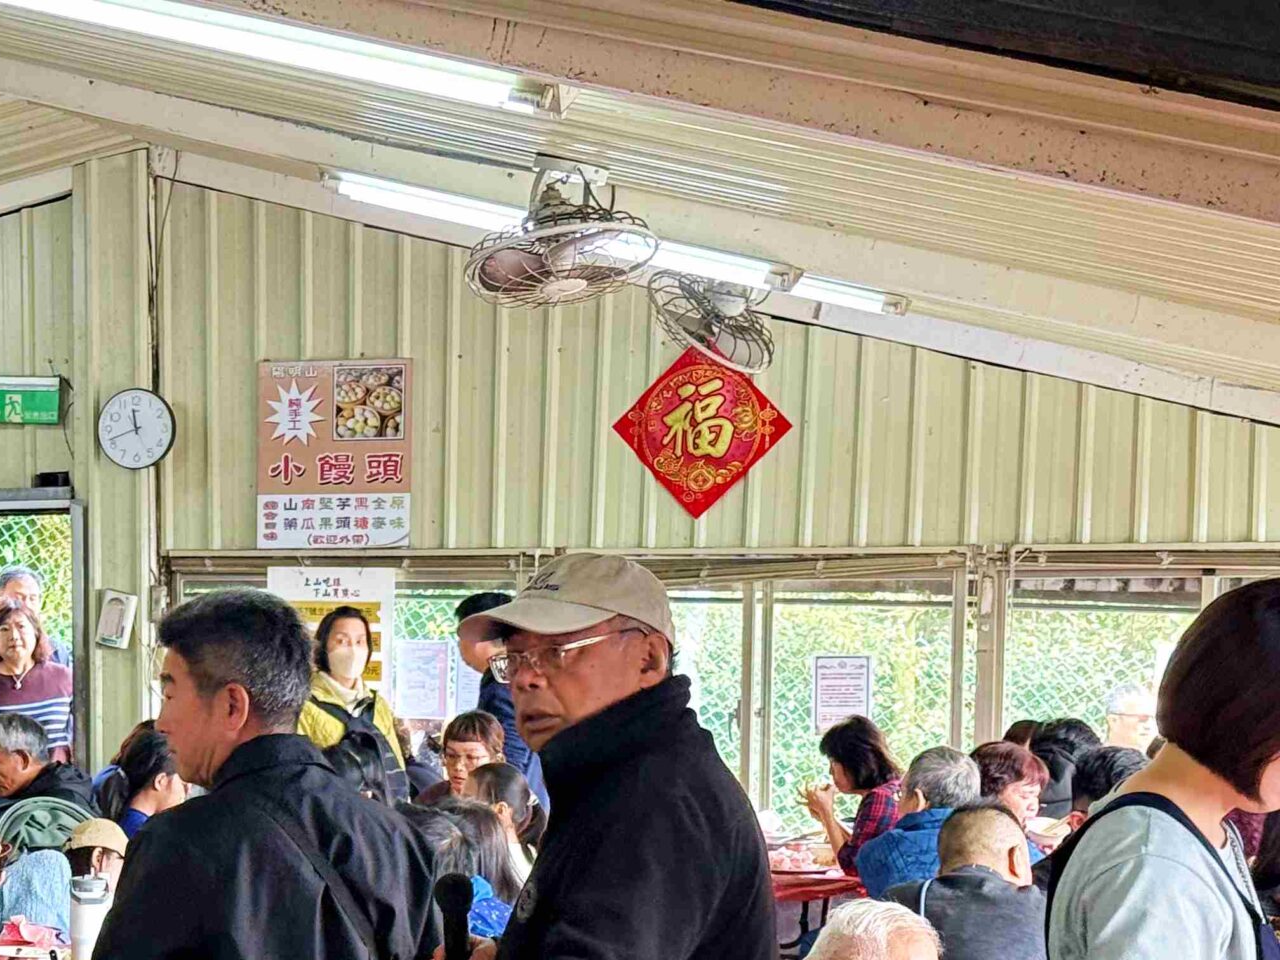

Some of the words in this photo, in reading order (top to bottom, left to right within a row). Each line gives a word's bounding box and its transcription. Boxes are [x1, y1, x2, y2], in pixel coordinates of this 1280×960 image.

[156, 408, 164, 419] 2
[662, 377, 735, 458] 福
[105, 425, 112, 435] 9
[161, 423, 168, 433] 3
[120, 449, 126, 459] 7
[133, 452, 141, 463] 6
[146, 448, 154, 458] 5
[269, 453, 404, 485] 小饅頭
